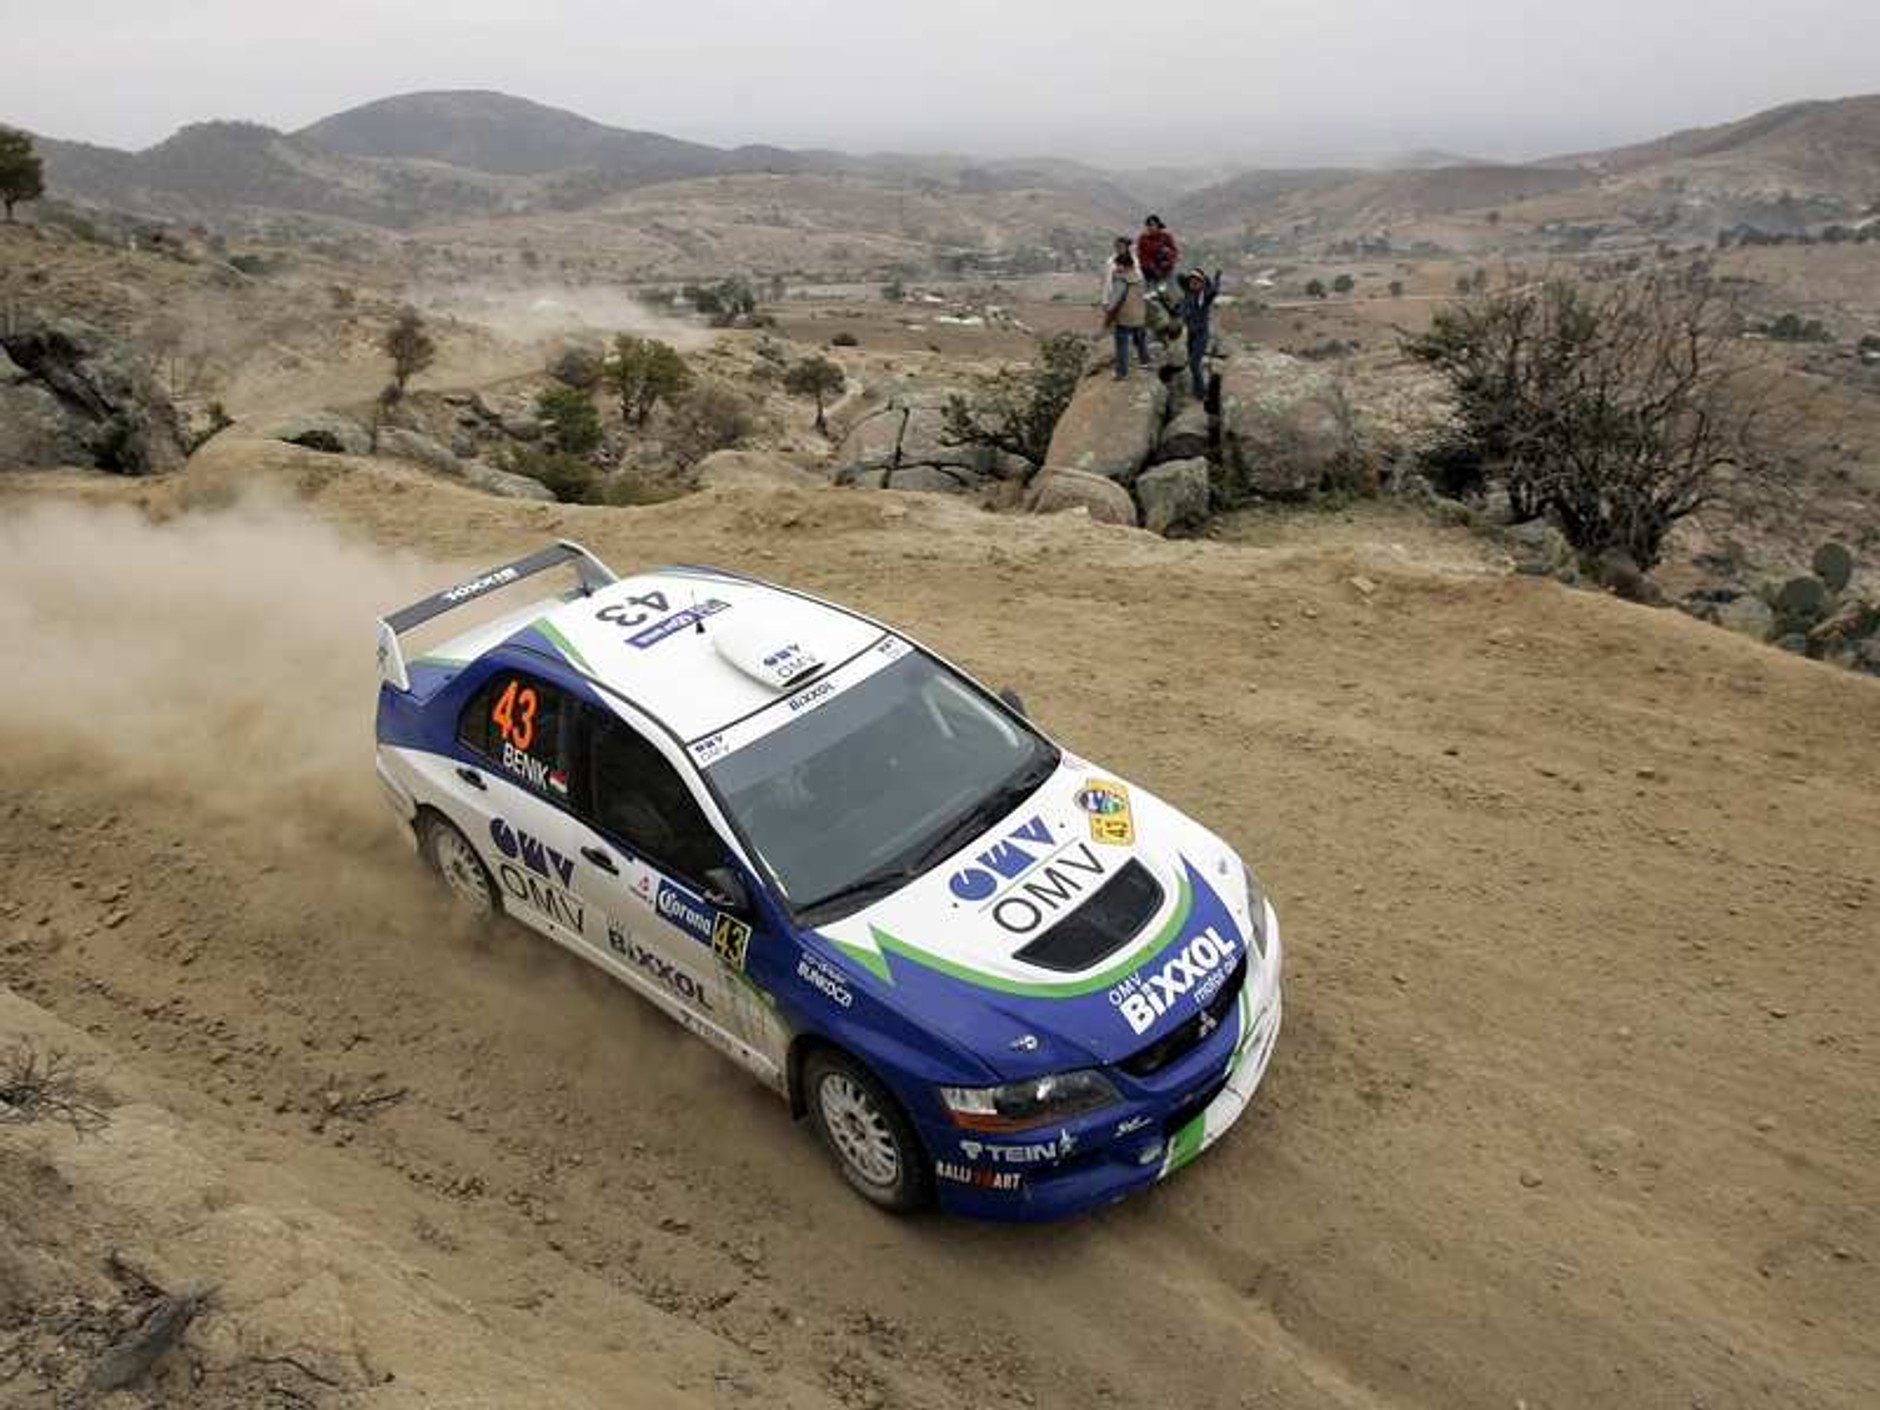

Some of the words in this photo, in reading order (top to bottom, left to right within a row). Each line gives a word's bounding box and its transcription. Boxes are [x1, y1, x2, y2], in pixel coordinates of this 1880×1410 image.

[596, 591, 669, 627] 43
[492, 680, 537, 751] 43
[502, 741, 549, 791] BENIK
[500, 863, 584, 935] OMV
[657, 887, 712, 937] Corona
[992, 843, 1105, 934] OMV
[715, 917, 746, 967] 43
[1108, 972, 1141, 1005] OMV
[985, 1142, 1057, 1162] TEIN
